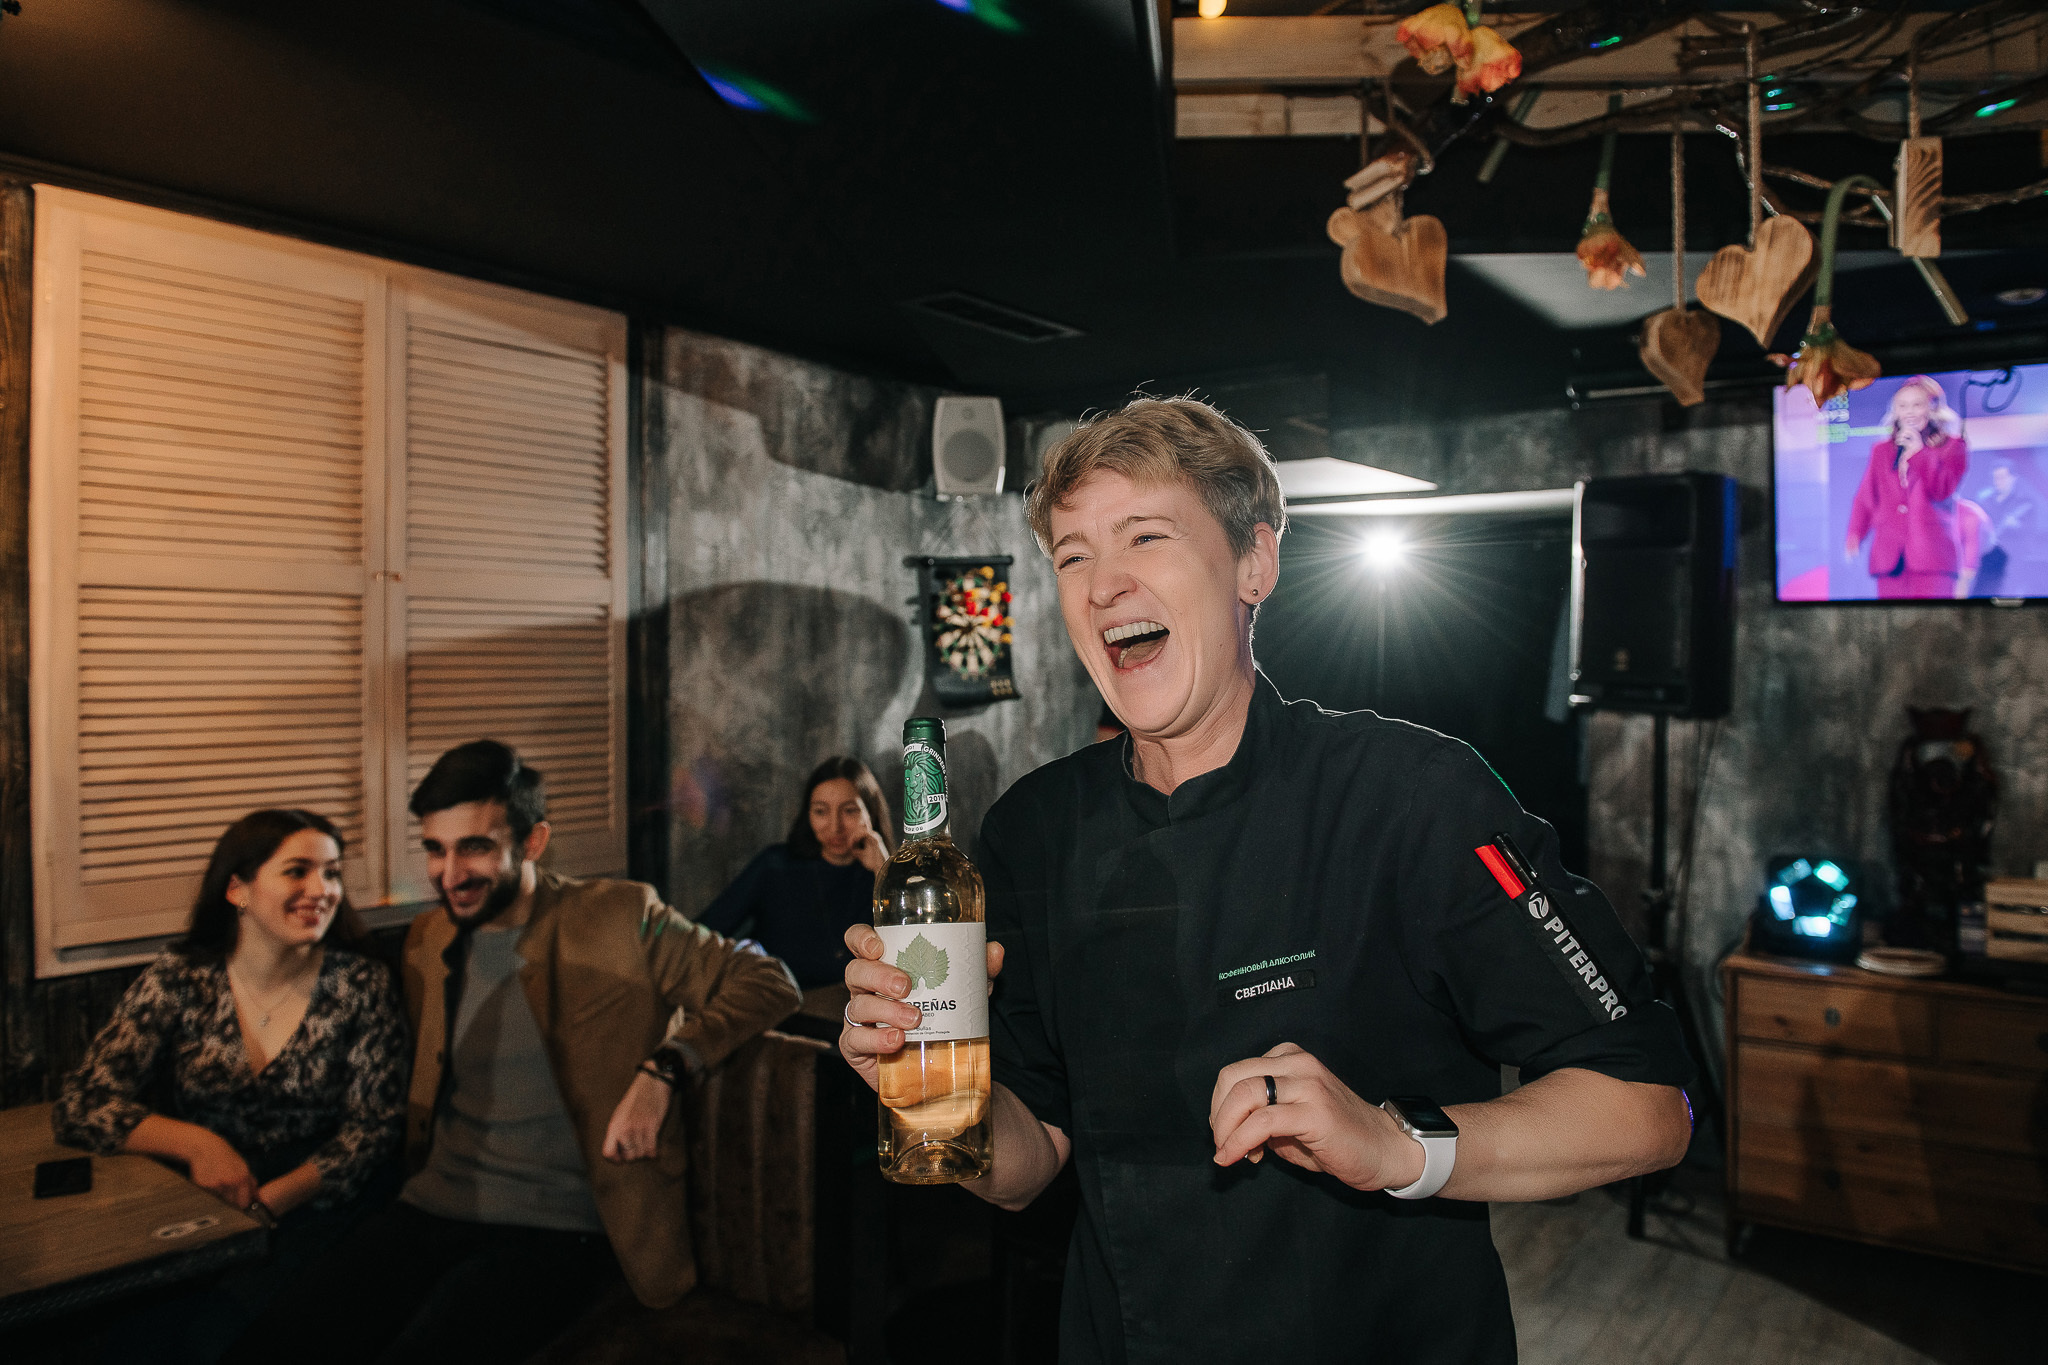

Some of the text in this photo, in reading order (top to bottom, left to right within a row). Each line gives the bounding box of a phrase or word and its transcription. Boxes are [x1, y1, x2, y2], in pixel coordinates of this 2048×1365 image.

[1268, 949, 1317, 967] АЛКОГОЛИК
[1543, 916, 1628, 1021] PITERPRO
[1235, 976, 1296, 1001] СВЕТЛАНА
[906, 998, 957, 1012] REÑAS
